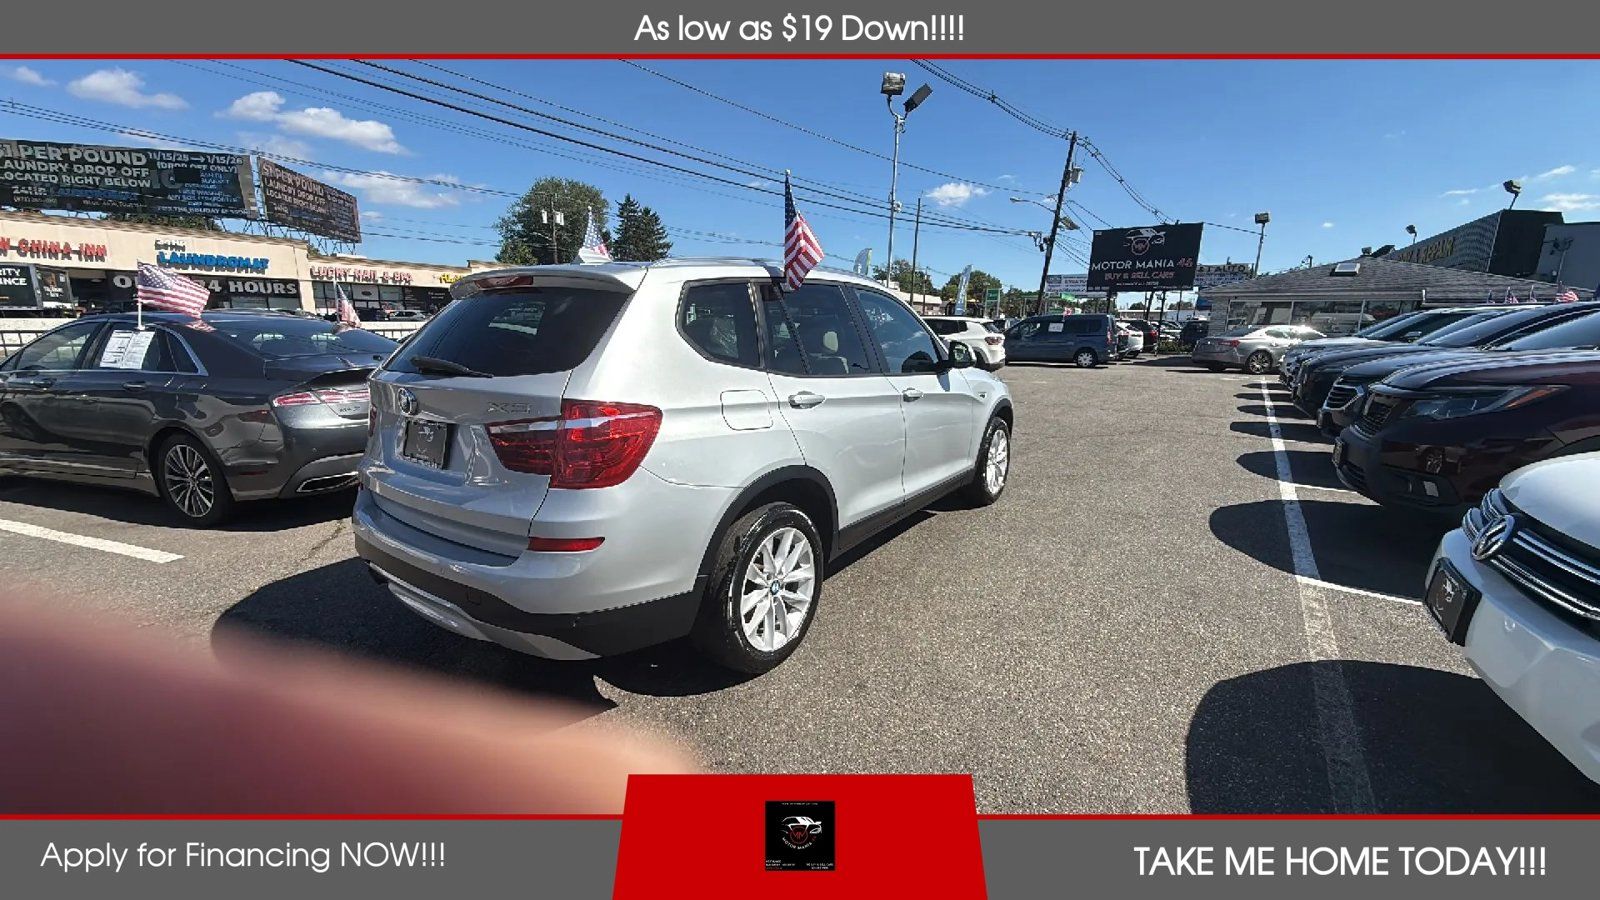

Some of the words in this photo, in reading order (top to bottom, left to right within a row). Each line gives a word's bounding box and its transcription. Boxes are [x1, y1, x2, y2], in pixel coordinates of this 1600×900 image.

[18, 144, 63, 161] PER
[68, 147, 148, 166] POUND
[72, 164, 116, 177] DROP
[121, 166, 150, 178] OFF
[61, 174, 101, 186] RIGHT
[104, 177, 151, 188] BELOW
[17, 239, 73, 259] CHINA
[78, 243, 107, 261] INN
[157, 251, 270, 272] LAUNDROMAT
[1091, 260, 1133, 271] MOTOR
[1135, 259, 1175, 270] MANIA
[228, 279, 298, 295] HOURS
